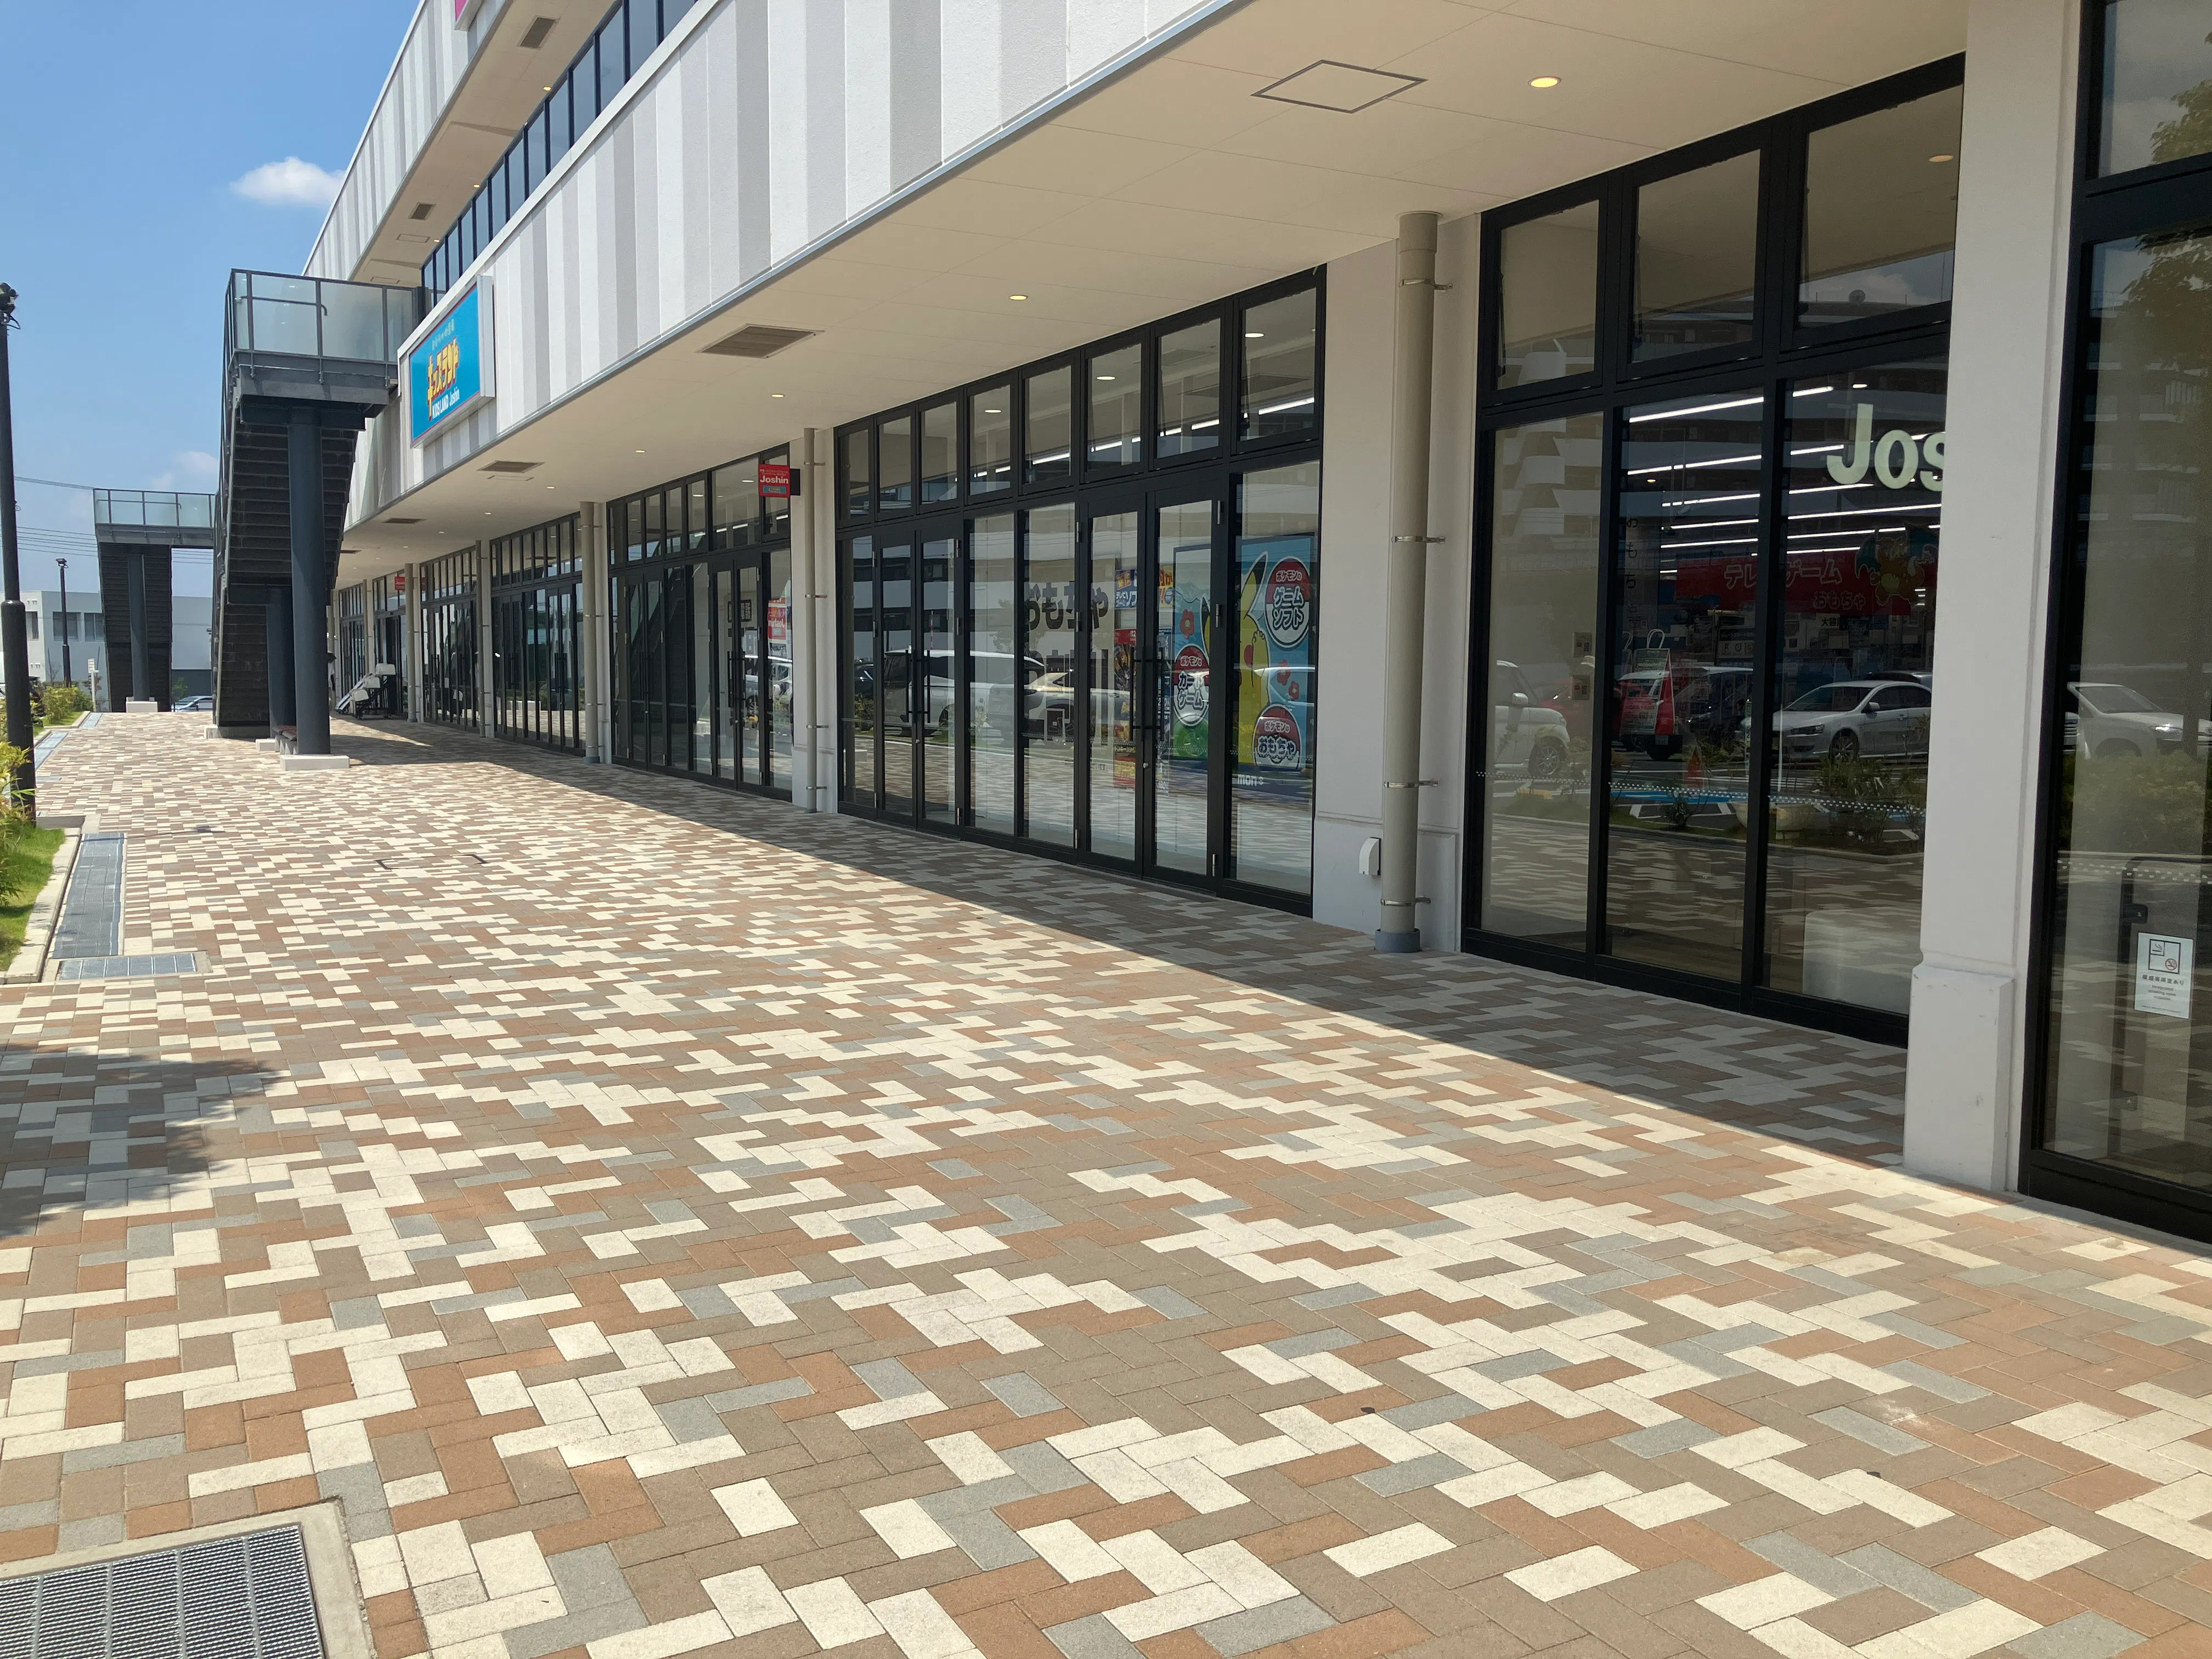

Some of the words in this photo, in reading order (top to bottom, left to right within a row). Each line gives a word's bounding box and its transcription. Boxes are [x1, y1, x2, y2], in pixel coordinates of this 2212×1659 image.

[449, 386, 460, 406] Joshin
[1826, 403, 1945, 492] Jos
[760, 475, 788, 484] Joshin
[1276, 570, 1302, 582] ポケモンの
[1723, 558, 1842, 589] テレゲーム
[1273, 586, 1304, 607] ゲーム
[1813, 590, 1866, 611] おもちゃ
[1273, 608, 1305, 629] ソフト
[1180, 656, 1202, 667] ポケモンの
[1178, 690, 1204, 709] ゲーム
[1265, 721, 1290, 733] ポケモンの
[1258, 736, 1296, 757] おもちゃ
